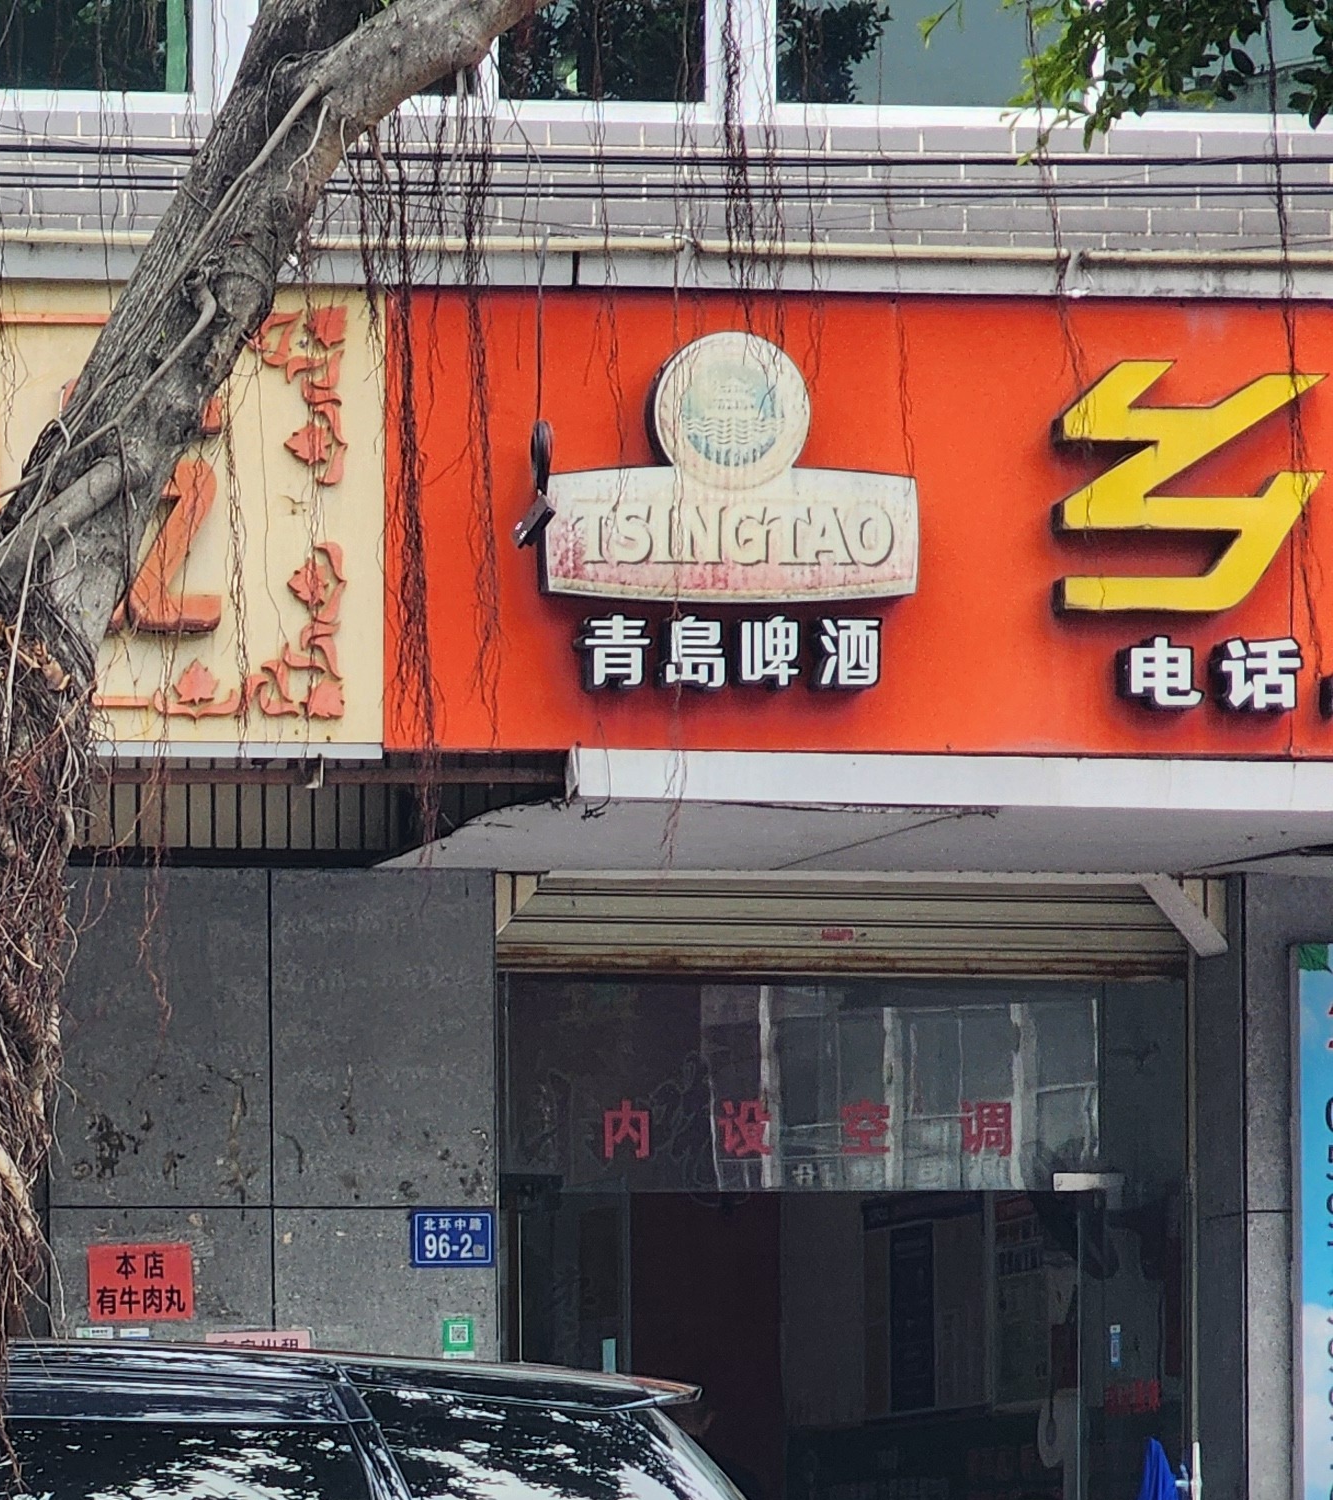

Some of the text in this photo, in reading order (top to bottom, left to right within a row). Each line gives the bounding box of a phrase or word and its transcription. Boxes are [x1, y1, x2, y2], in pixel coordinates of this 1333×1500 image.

[1062, 359, 1329, 612] 乡
[572, 502, 895, 567] TSINGTAO
[1129, 635, 1303, 709] 电话
[602, 1099, 1014, 1160] 内设空调
[423, 1217, 483, 1232] 北环中路
[424, 1233, 473, 1260] 96-2
[115, 1251, 165, 1280] 本店
[96, 1284, 187, 1315] 有牛肉丸
